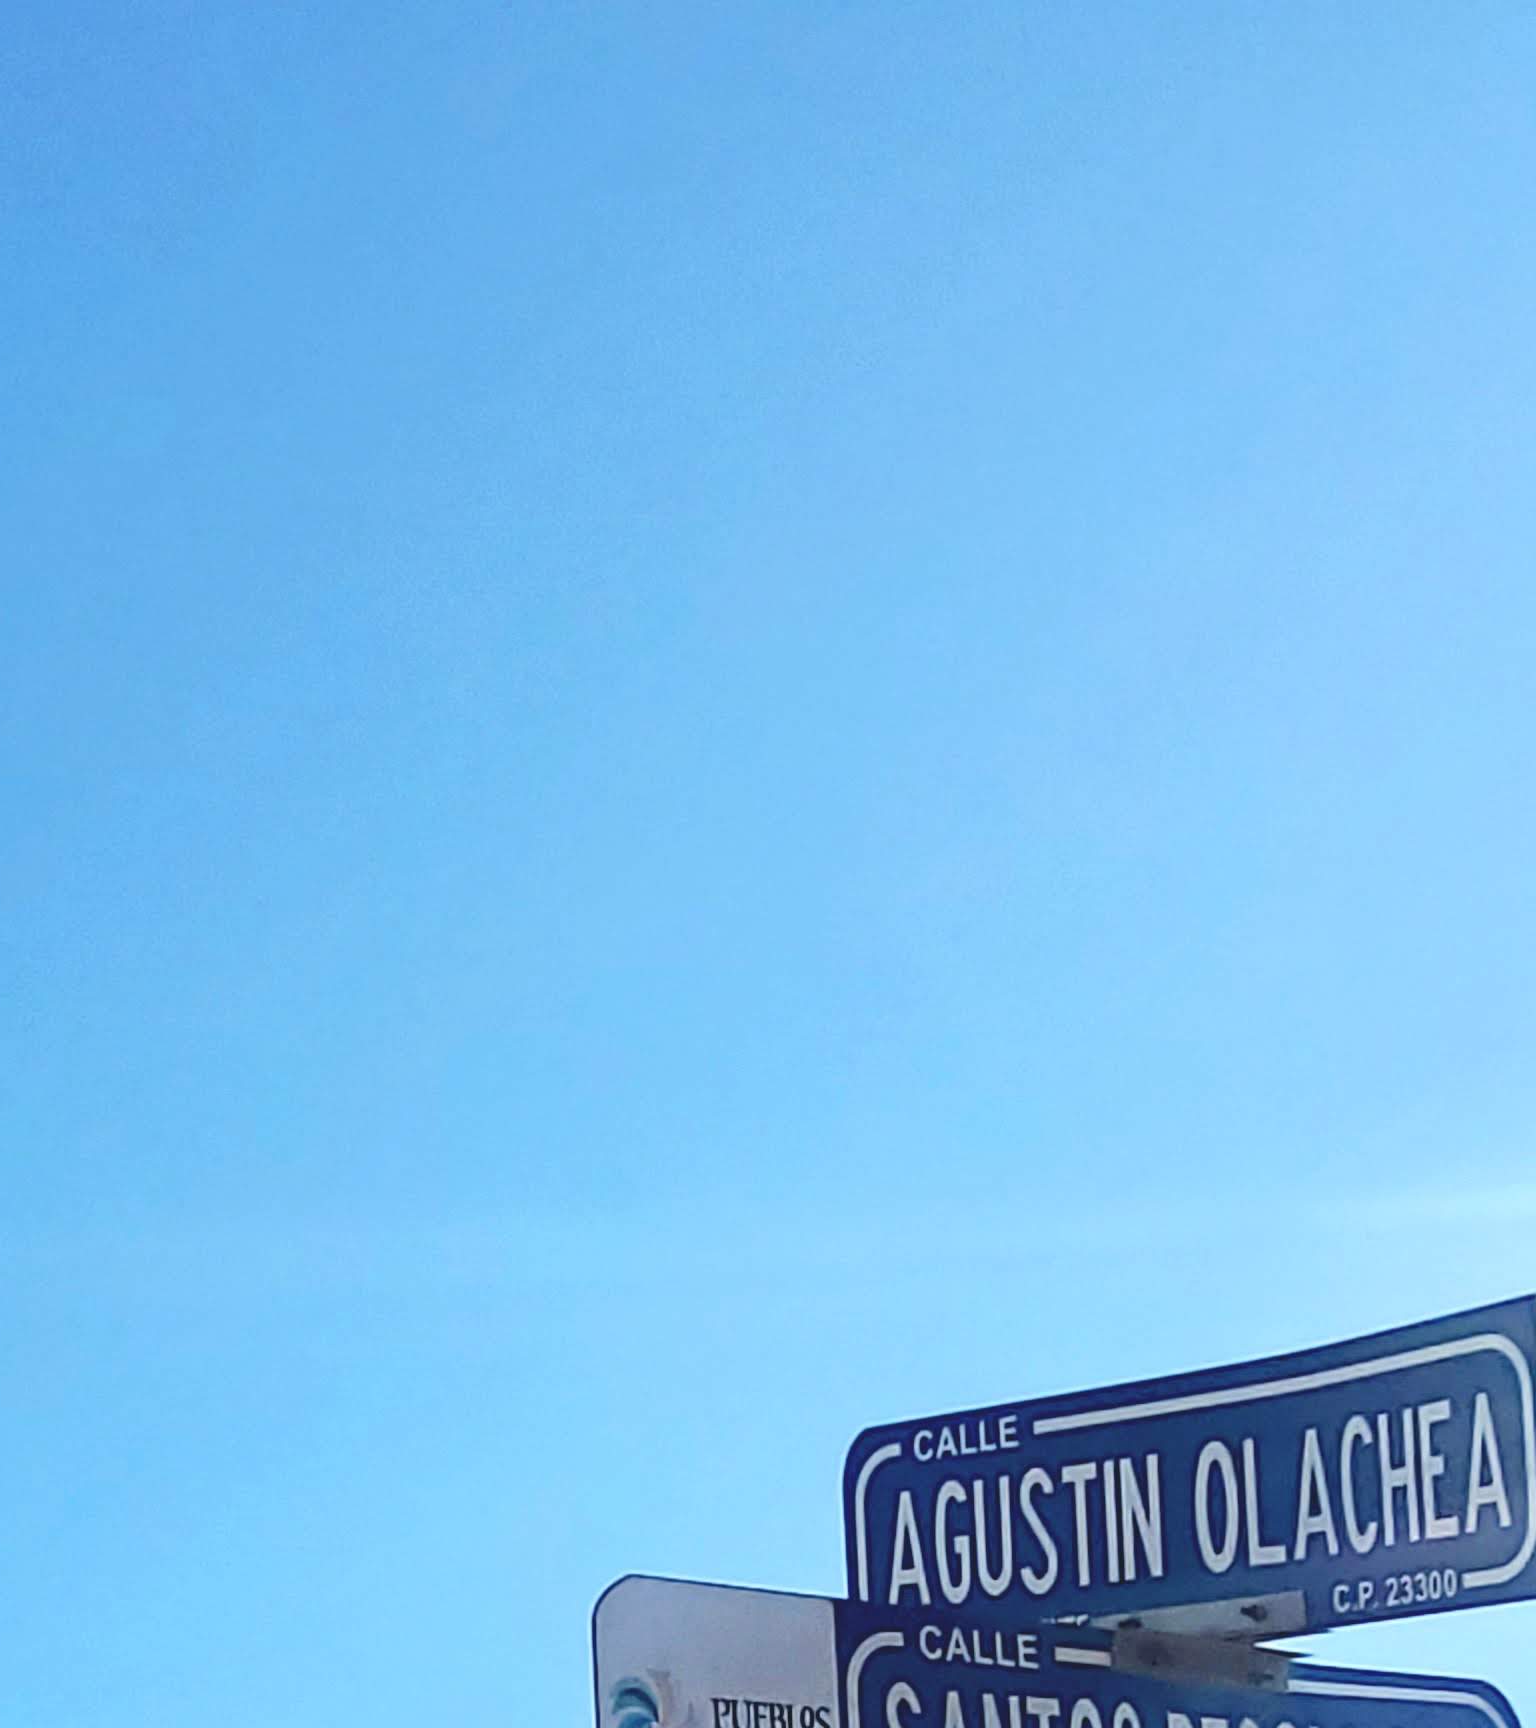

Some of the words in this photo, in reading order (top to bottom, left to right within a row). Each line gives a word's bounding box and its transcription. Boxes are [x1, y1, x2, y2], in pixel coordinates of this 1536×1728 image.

[913, 1414, 1021, 1463] CALLE
[887, 1452, 1164, 1606] AGUSTIN
[1194, 1392, 1513, 1575] OLACHEA
[1385, 1568, 1458, 1607] 23300
[918, 1625, 1041, 1670] CALLE
